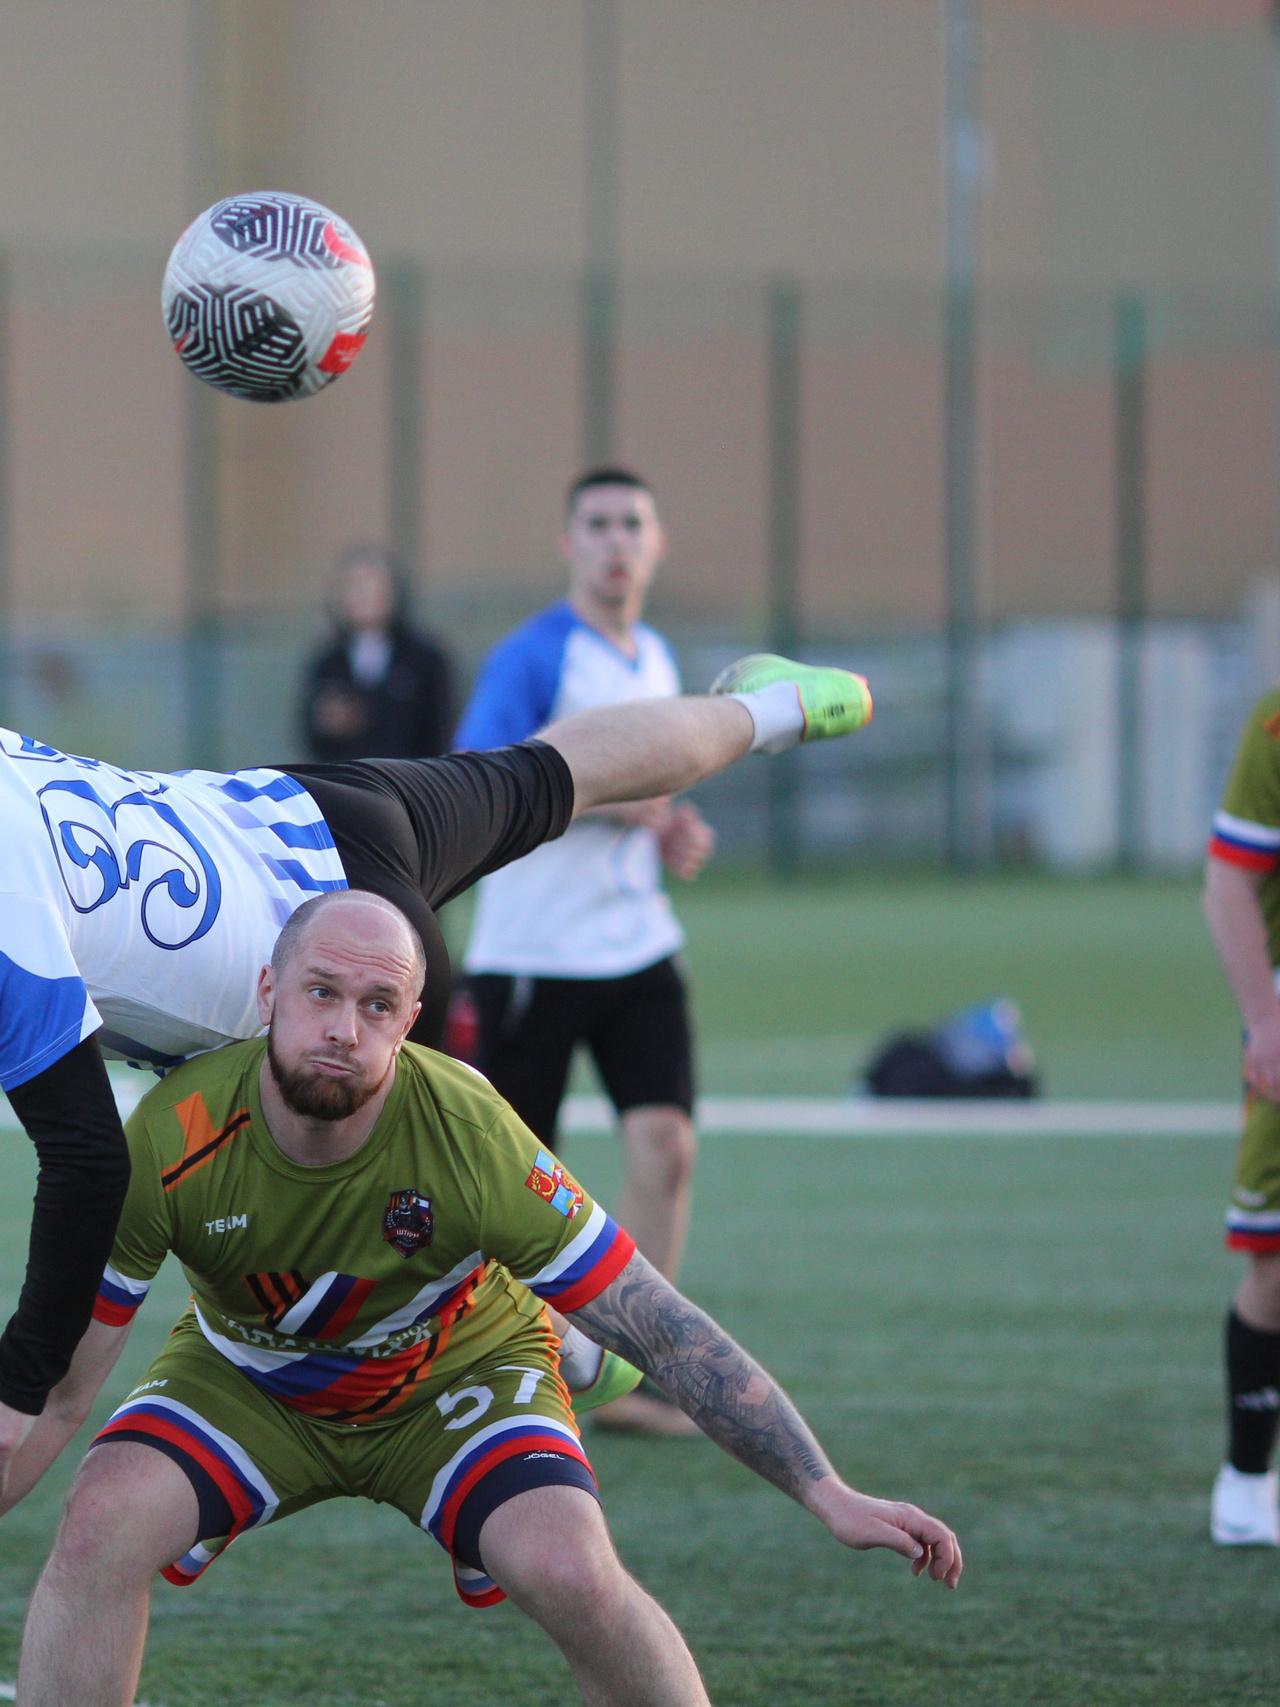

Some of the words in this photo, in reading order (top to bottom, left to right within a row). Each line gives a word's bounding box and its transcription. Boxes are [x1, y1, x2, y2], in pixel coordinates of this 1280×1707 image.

[205, 1213, 248, 1236] TEAM
[435, 1365, 545, 1430] 57
[523, 1451, 565, 1461] JÖGEL
